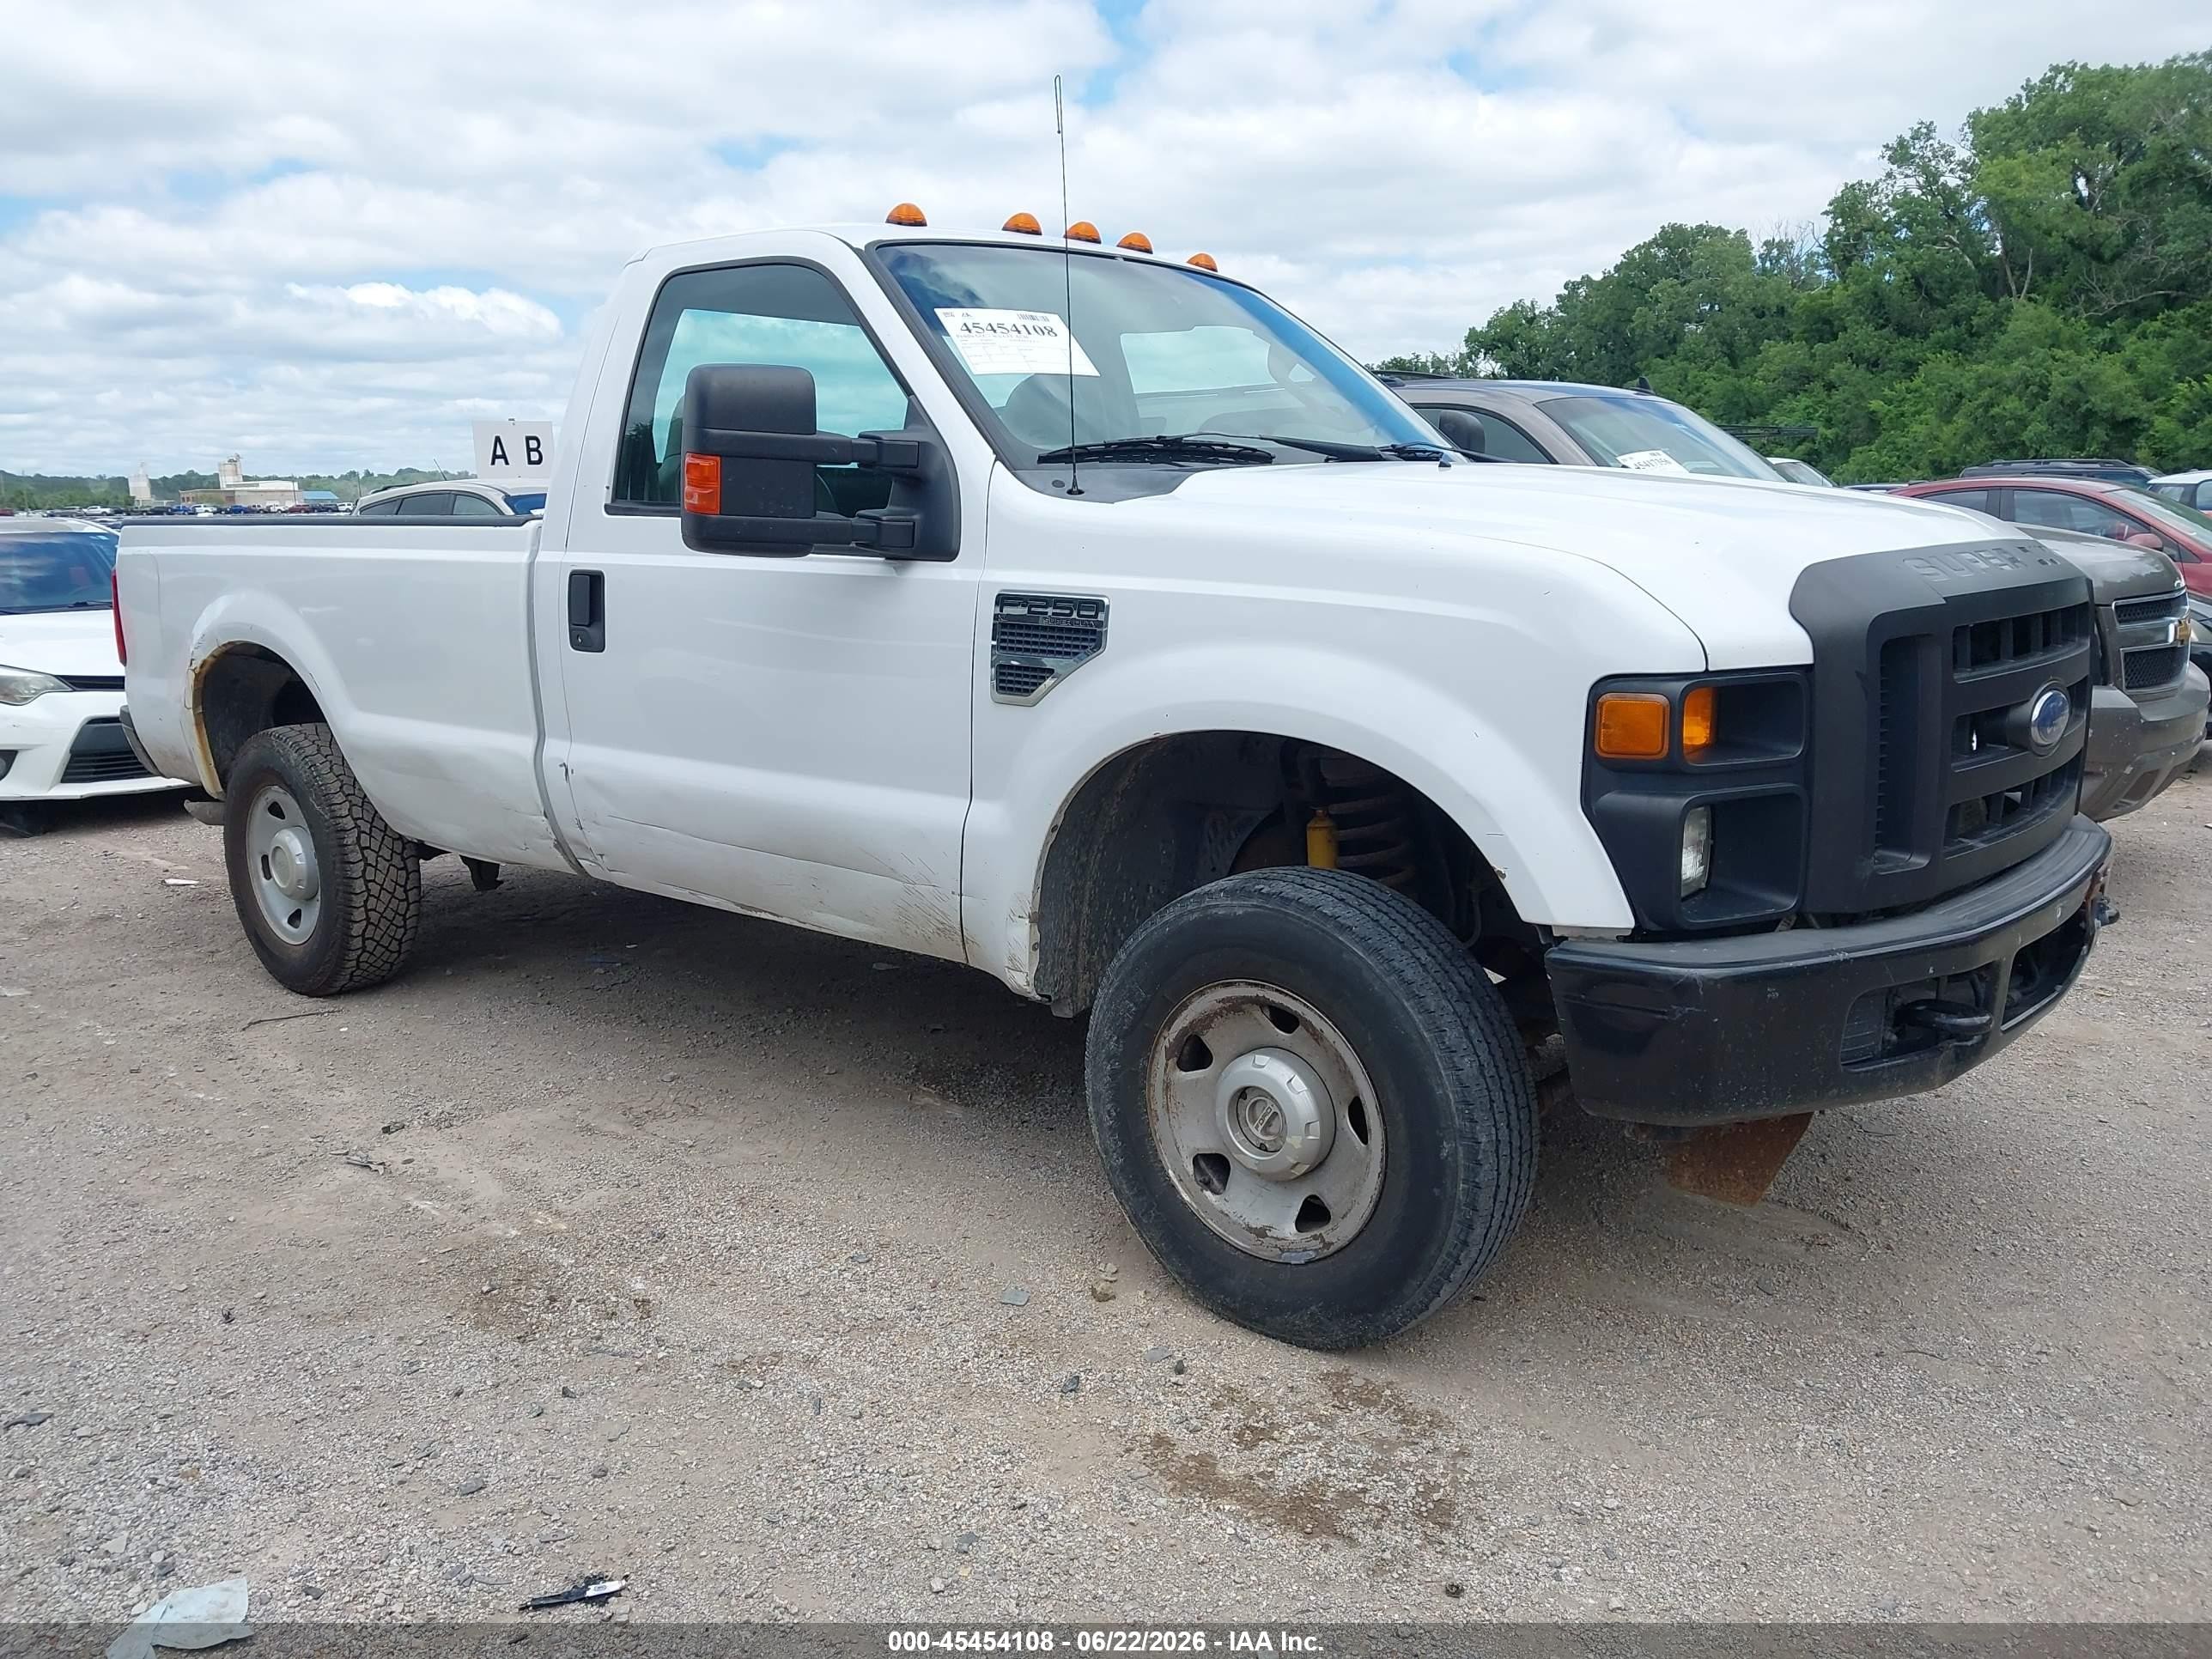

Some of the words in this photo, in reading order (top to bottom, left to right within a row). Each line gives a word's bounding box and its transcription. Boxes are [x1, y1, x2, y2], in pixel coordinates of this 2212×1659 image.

[960, 322, 1058, 337] 45454108
[490, 435, 510, 465] A
[525, 435, 544, 465] B
